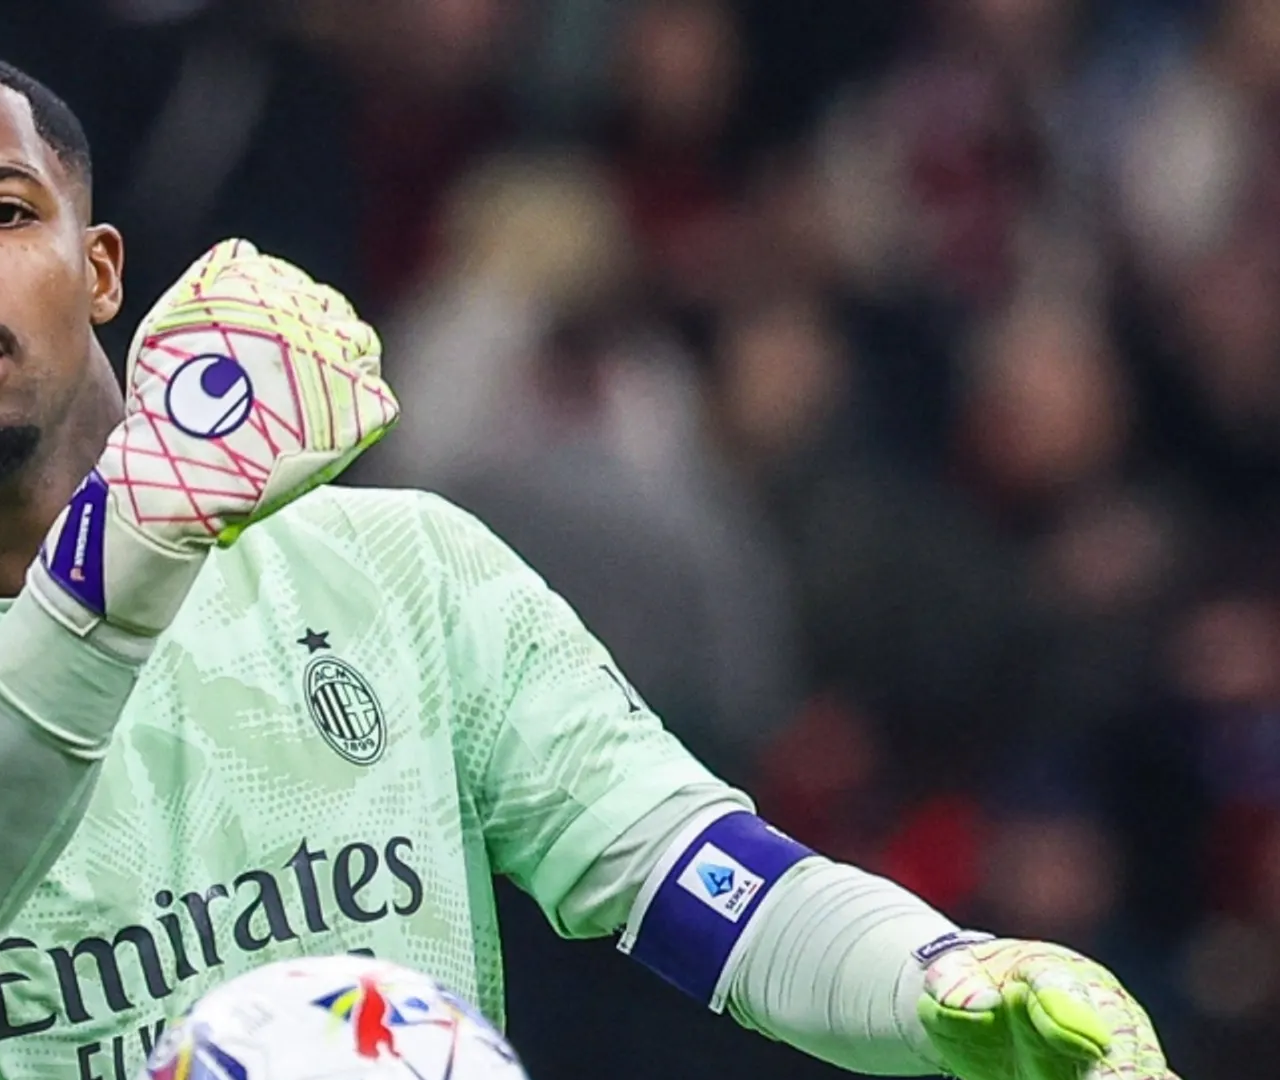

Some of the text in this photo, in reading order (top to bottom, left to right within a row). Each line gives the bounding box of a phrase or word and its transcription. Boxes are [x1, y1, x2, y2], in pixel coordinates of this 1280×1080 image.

[315, 665, 351, 682] ACM
[343, 738, 375, 751] 1899
[725, 887, 745, 910] SERIE
